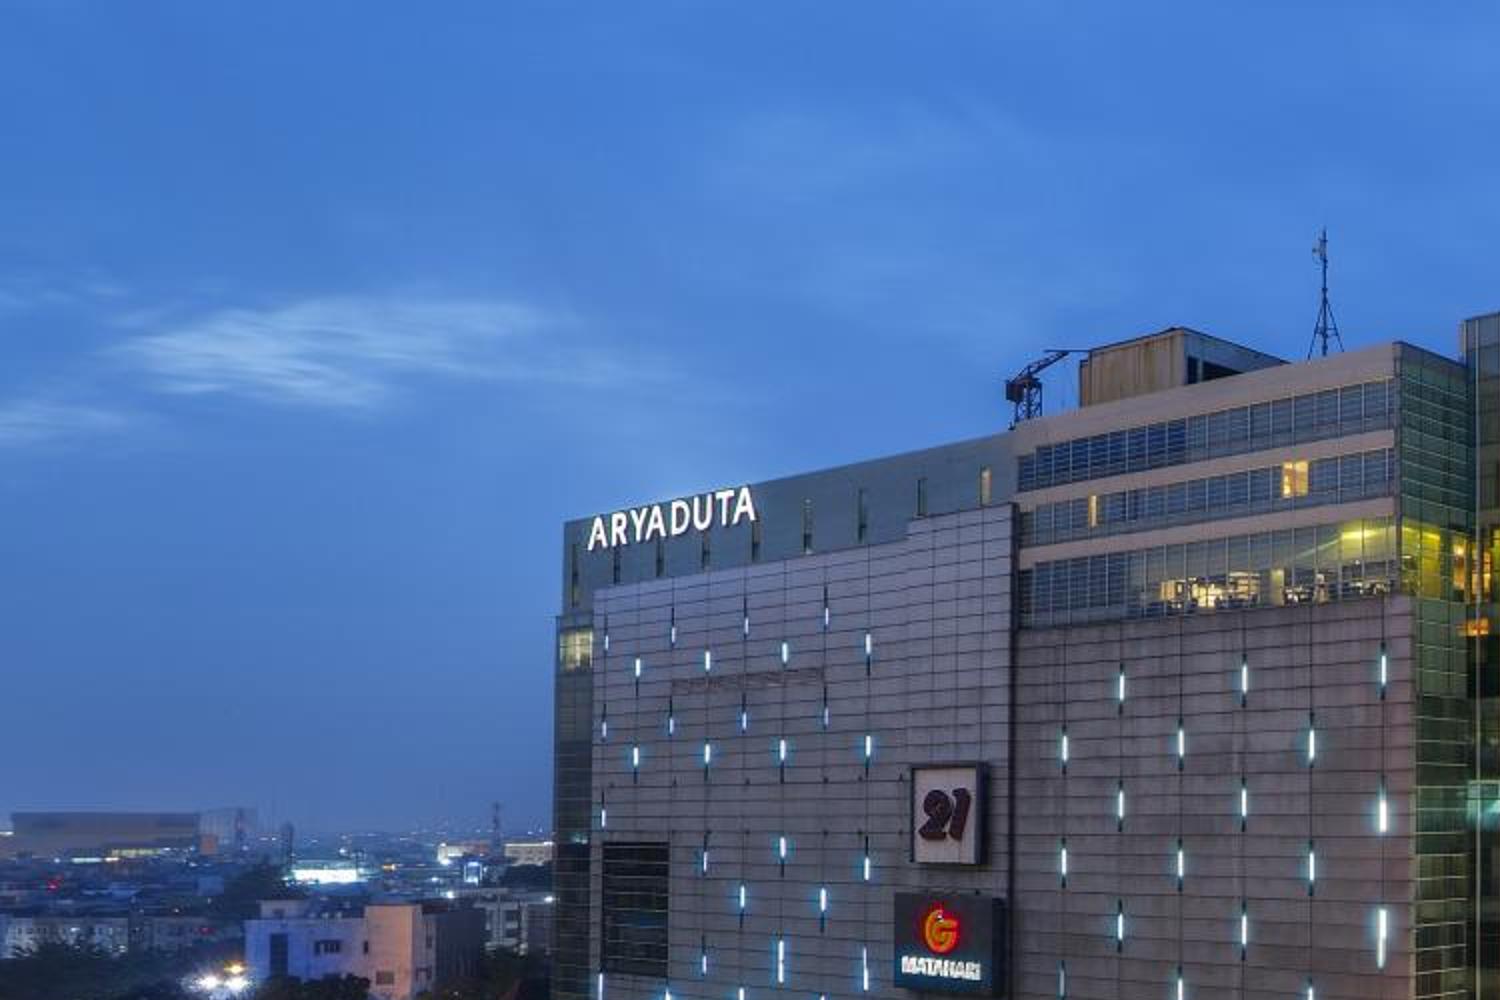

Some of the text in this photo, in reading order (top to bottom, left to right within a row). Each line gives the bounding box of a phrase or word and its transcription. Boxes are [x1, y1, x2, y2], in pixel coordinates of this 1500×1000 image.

[587, 486, 757, 551] ARYADUTA
[918, 787, 972, 842] 21
[901, 955, 981, 981] MATAHARI
